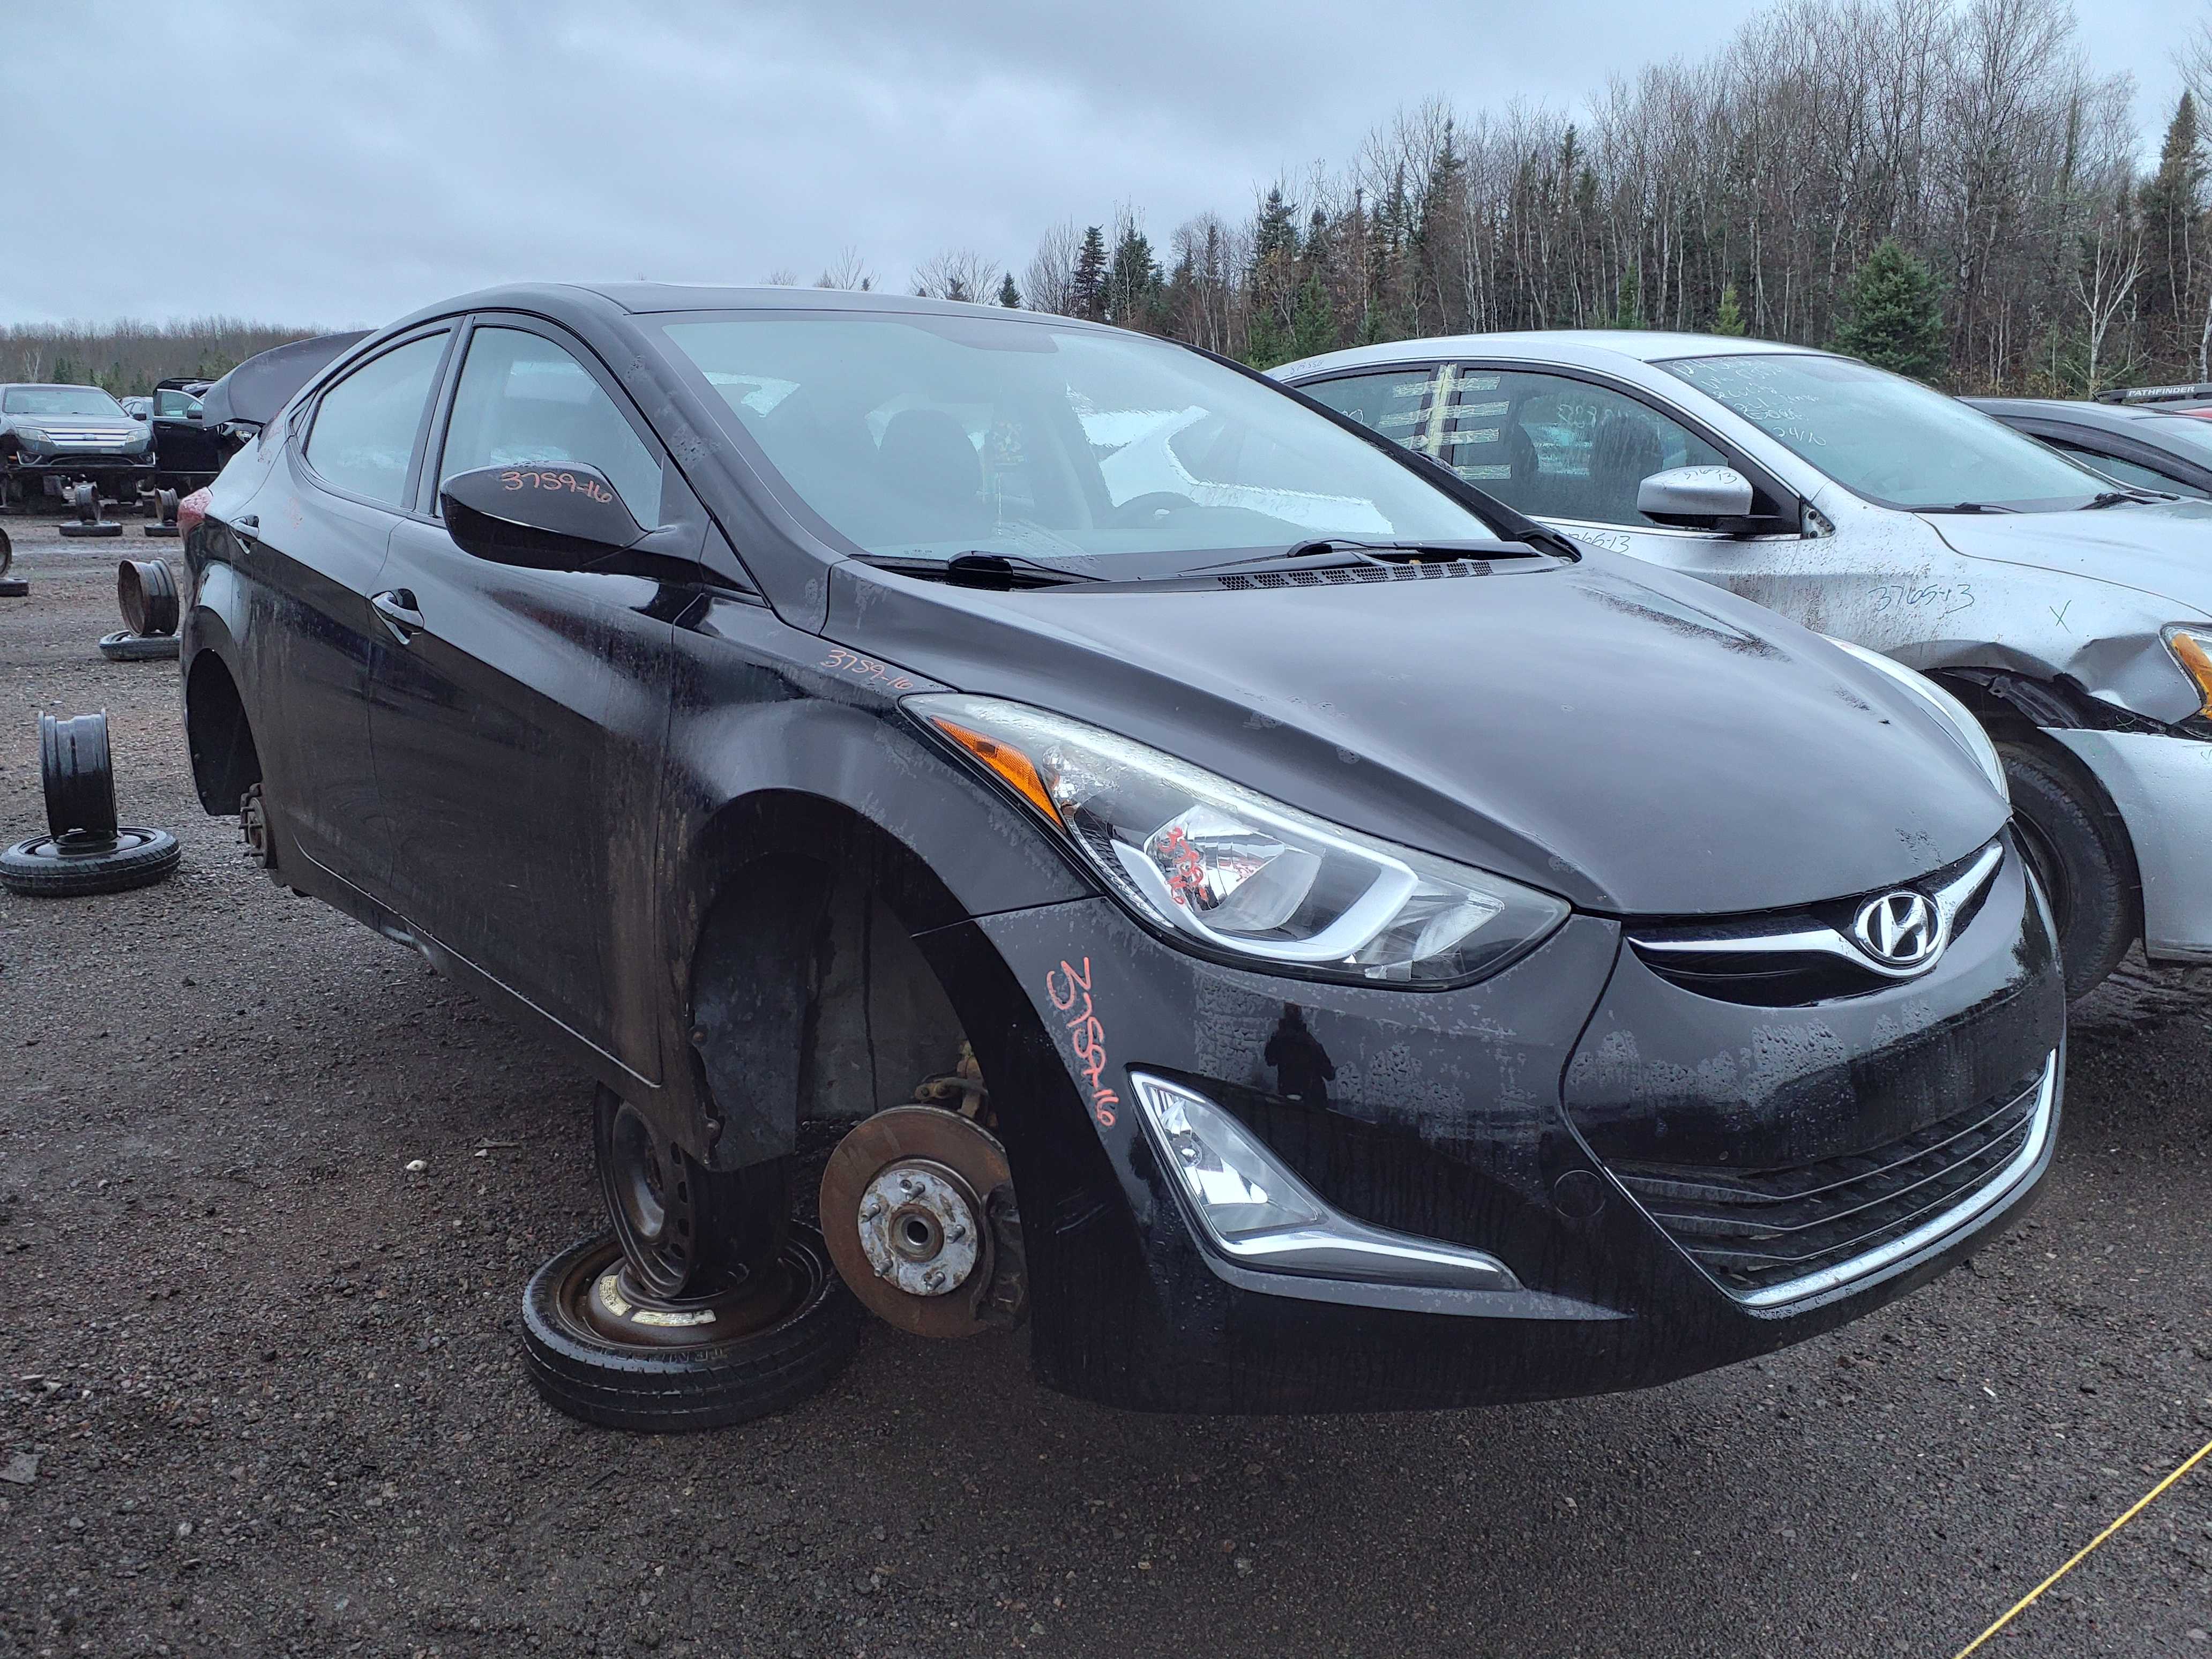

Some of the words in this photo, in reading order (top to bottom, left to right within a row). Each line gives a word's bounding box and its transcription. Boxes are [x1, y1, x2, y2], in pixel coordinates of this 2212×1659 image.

[2128, 386, 2195, 397] PATHFINDER
[501, 471, 613, 503] 3759-16
[820, 649, 914, 690] 3759-16
